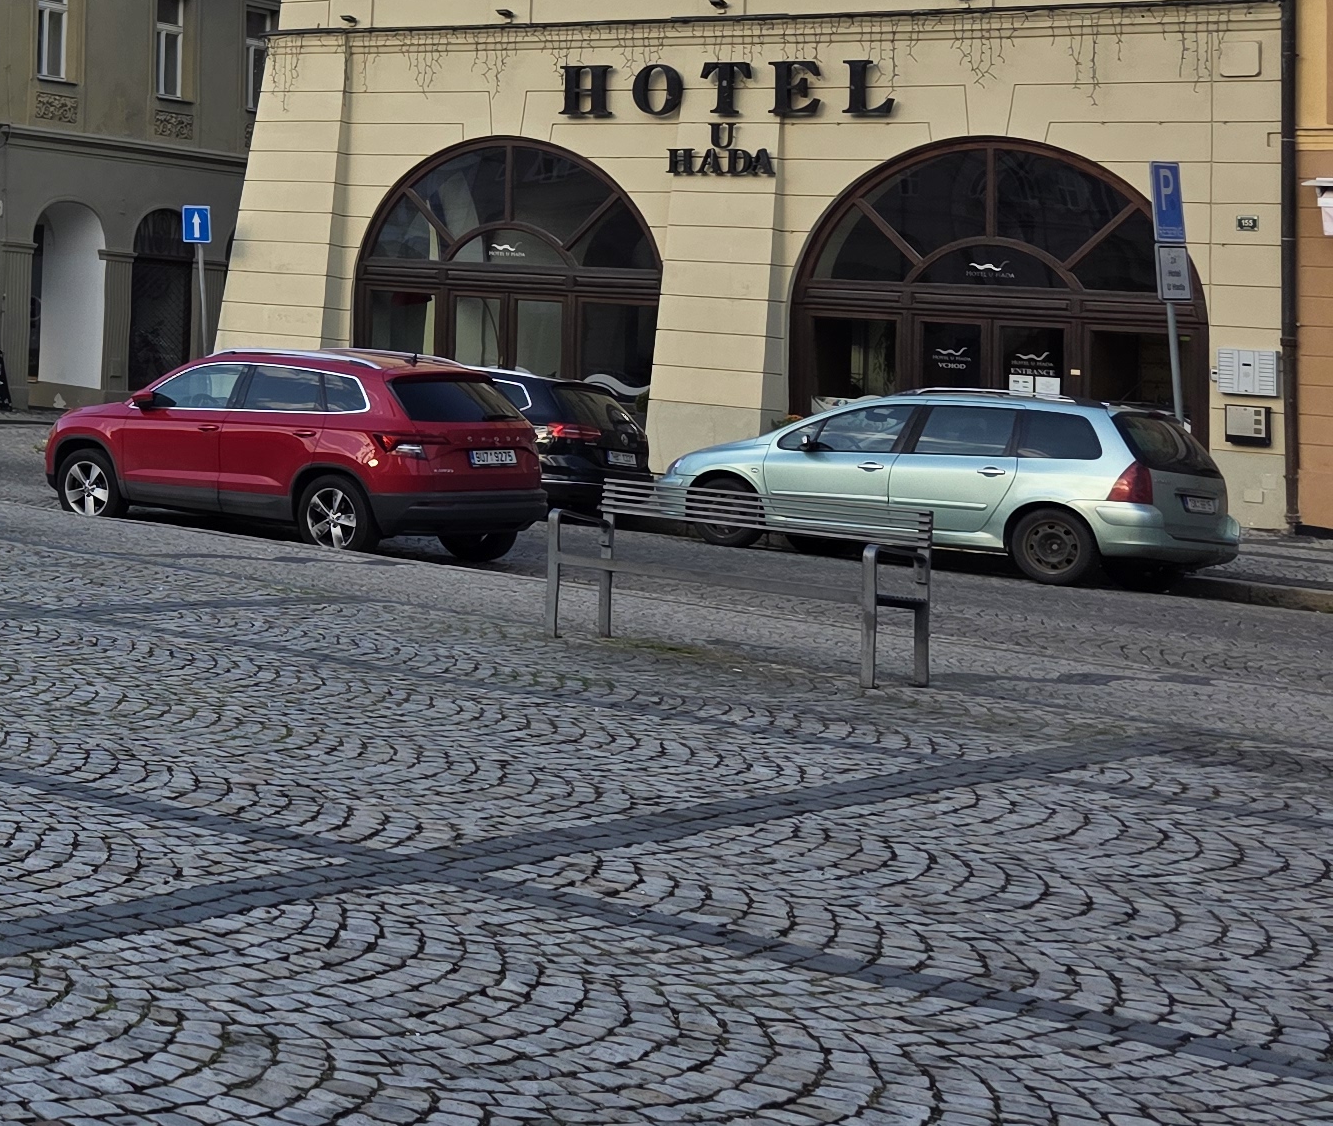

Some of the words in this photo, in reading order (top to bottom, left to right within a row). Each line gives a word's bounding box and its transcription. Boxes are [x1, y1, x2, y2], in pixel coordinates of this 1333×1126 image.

[558, 60, 896, 118] HOTEL
[708, 123, 737, 149] U
[666, 148, 776, 177] HADA
[1158, 168, 1174, 211] P
[1241, 219, 1254, 227] 155
[965, 270, 987, 278] HOTEL
[937, 362, 967, 370] VCHOD
[1010, 367, 1056, 376] ENTRANCE
